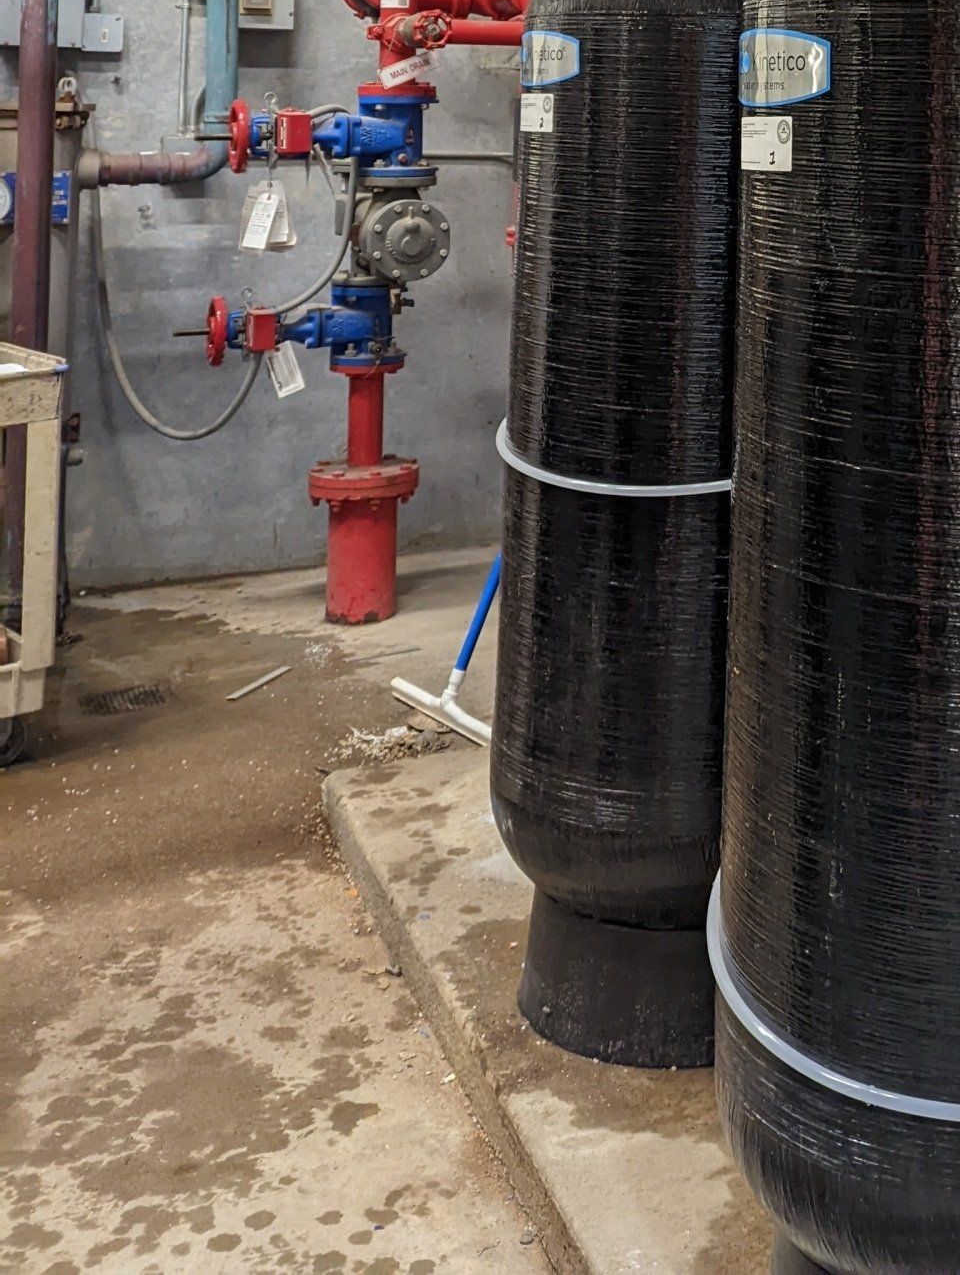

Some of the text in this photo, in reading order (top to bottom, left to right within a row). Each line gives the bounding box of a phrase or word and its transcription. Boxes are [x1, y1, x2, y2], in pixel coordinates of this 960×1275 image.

[390, 57, 431, 79] MAIN DRAIN
[752, 50, 806, 71] Kinetico
